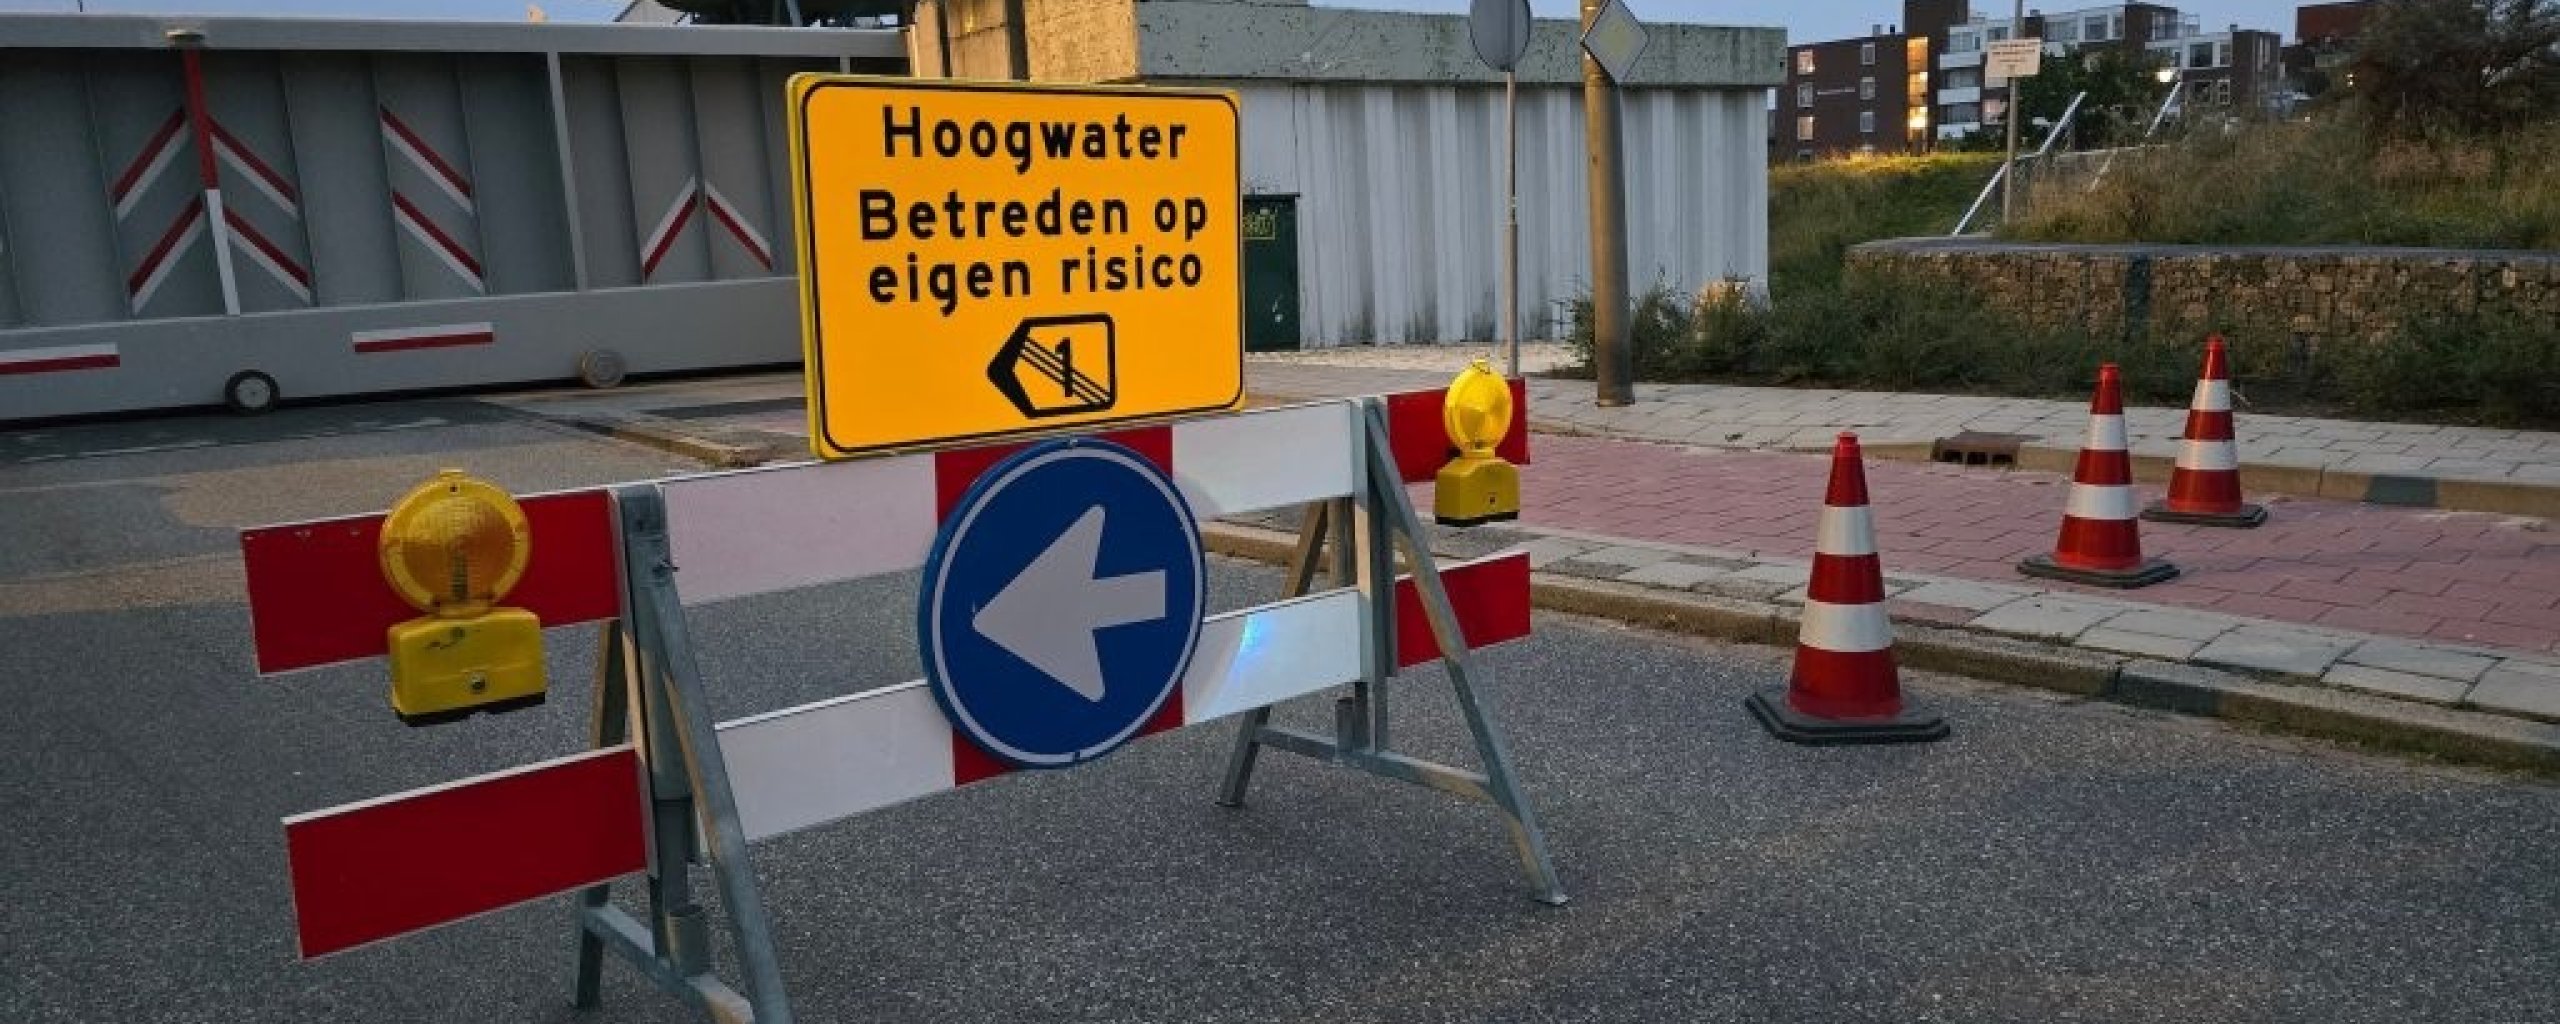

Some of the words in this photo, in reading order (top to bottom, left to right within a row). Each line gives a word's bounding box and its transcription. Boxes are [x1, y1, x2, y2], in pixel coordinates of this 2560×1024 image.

[882, 104, 1187, 174] Hoogwater
[859, 188, 1129, 241] Betreden
[1154, 196, 1208, 241] op
[868, 252, 1031, 317] eigen
[1061, 244, 1203, 293] risico
[1054, 336, 1075, 398] 1
